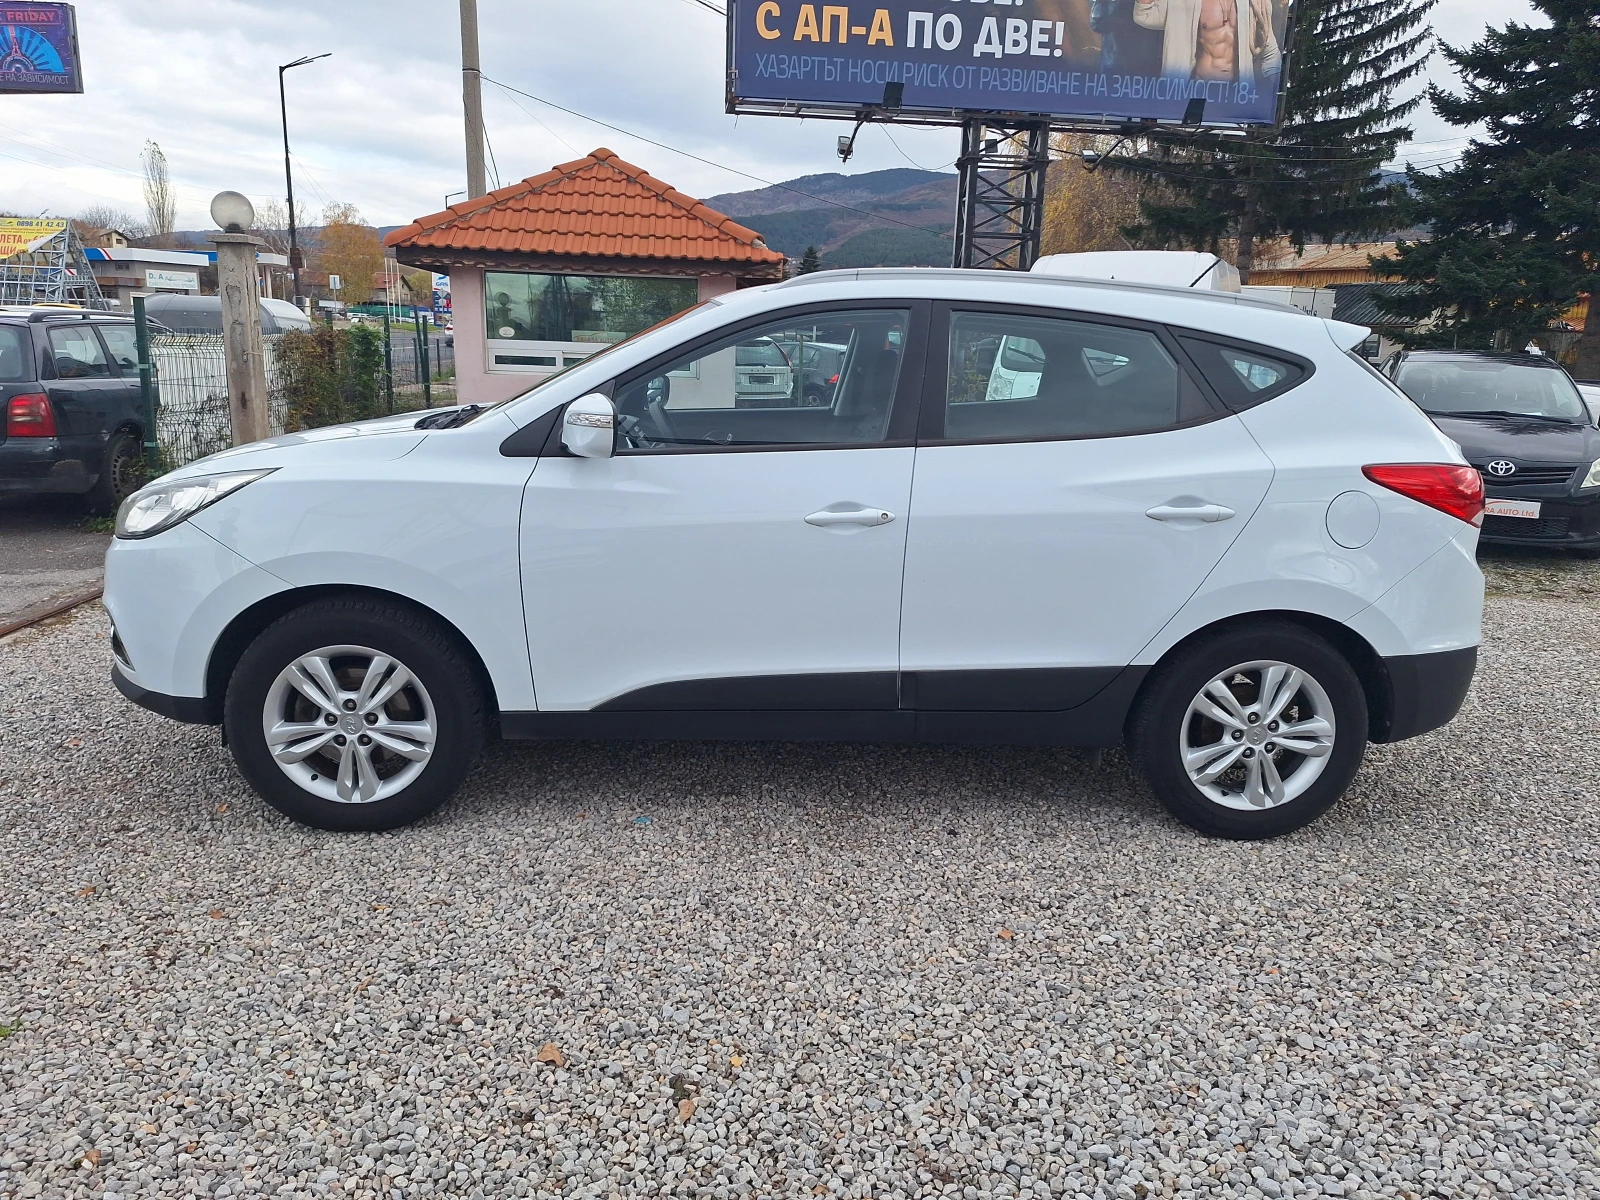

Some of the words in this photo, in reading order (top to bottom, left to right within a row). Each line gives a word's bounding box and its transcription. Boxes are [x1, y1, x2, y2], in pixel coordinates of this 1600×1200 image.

[6, 11, 55, 21] FRIDAY
[755, 1, 781, 40] С
[793, 3, 894, 47] АП-А
[906, 11, 962, 51] ПО
[972, 16, 1065, 59] ДВЕ!
[5, 73, 16, 82] НА
[17, 73, 70, 85] ЗАВИСИМОСТ
[755, 53, 845, 82] ХАЗАРТЪТ
[849, 59, 898, 84] НОСИ
[902, 62, 949, 88] РИСК
[952, 65, 976, 89] ОТ
[979, 67, 1080, 96] РАЗВИВАНЕ
[1084, 73, 1107, 97] НА
[1111, 75, 1230, 104] ЗАВИСИМОСТ!
[1232, 81, 1259, 105] 18+
